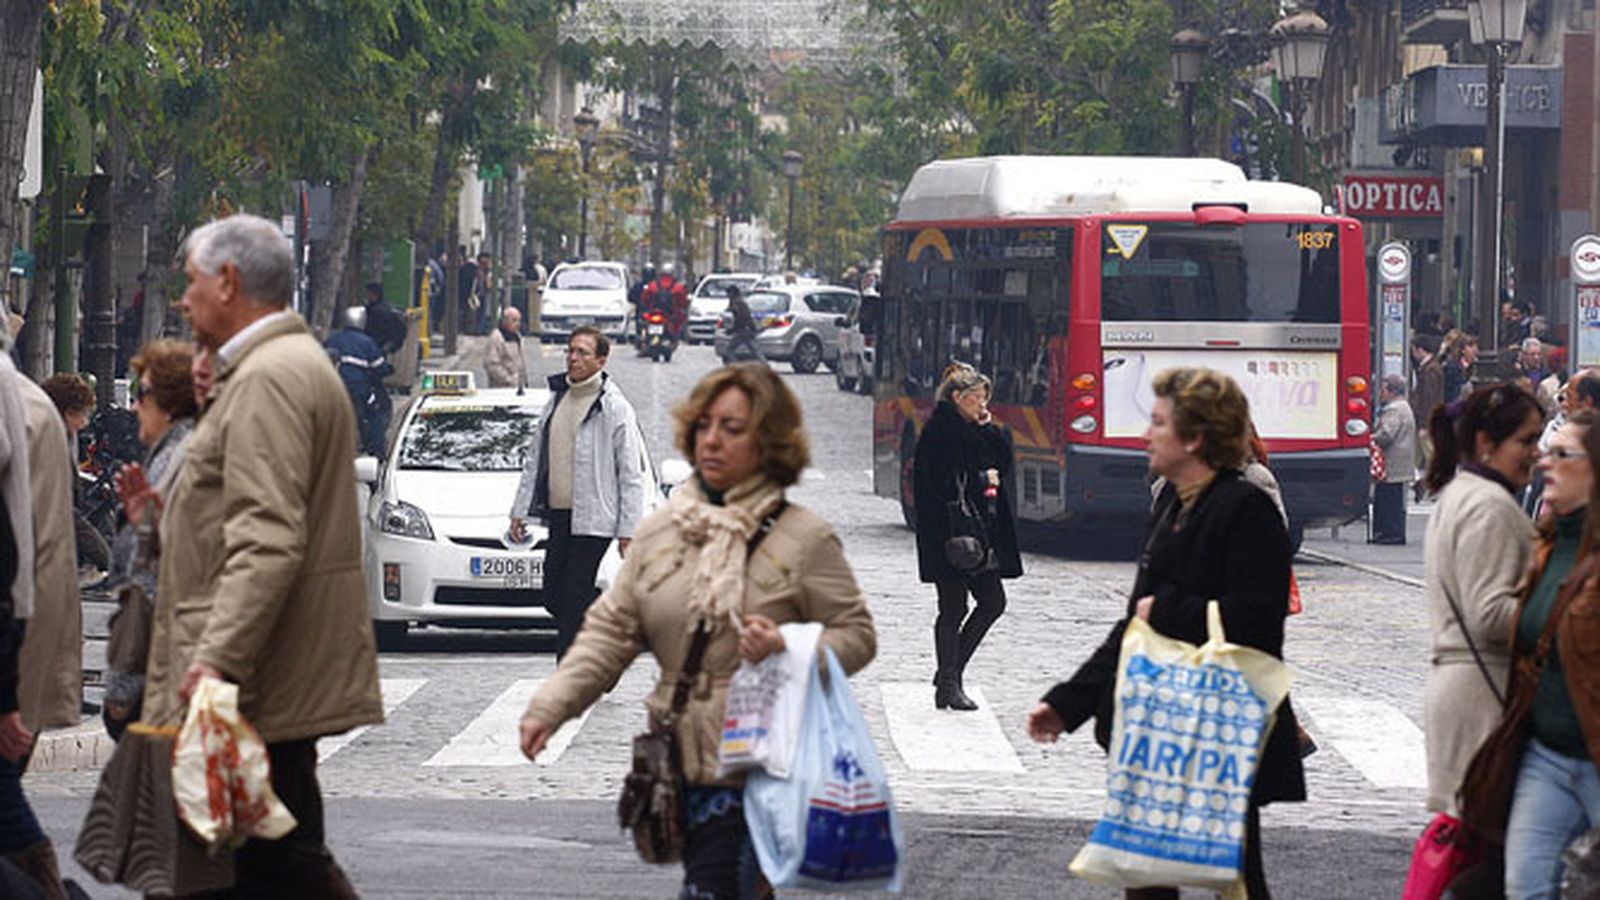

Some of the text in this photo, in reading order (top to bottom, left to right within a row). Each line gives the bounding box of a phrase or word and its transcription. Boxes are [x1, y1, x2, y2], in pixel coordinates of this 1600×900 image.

[1458, 83, 1551, 111] VEICE
[1347, 181, 1442, 212] OPTICA
[1296, 231, 1334, 249] 1837
[483, 558, 526, 575] 2006
[1118, 733, 1257, 790] ARYPAZ
